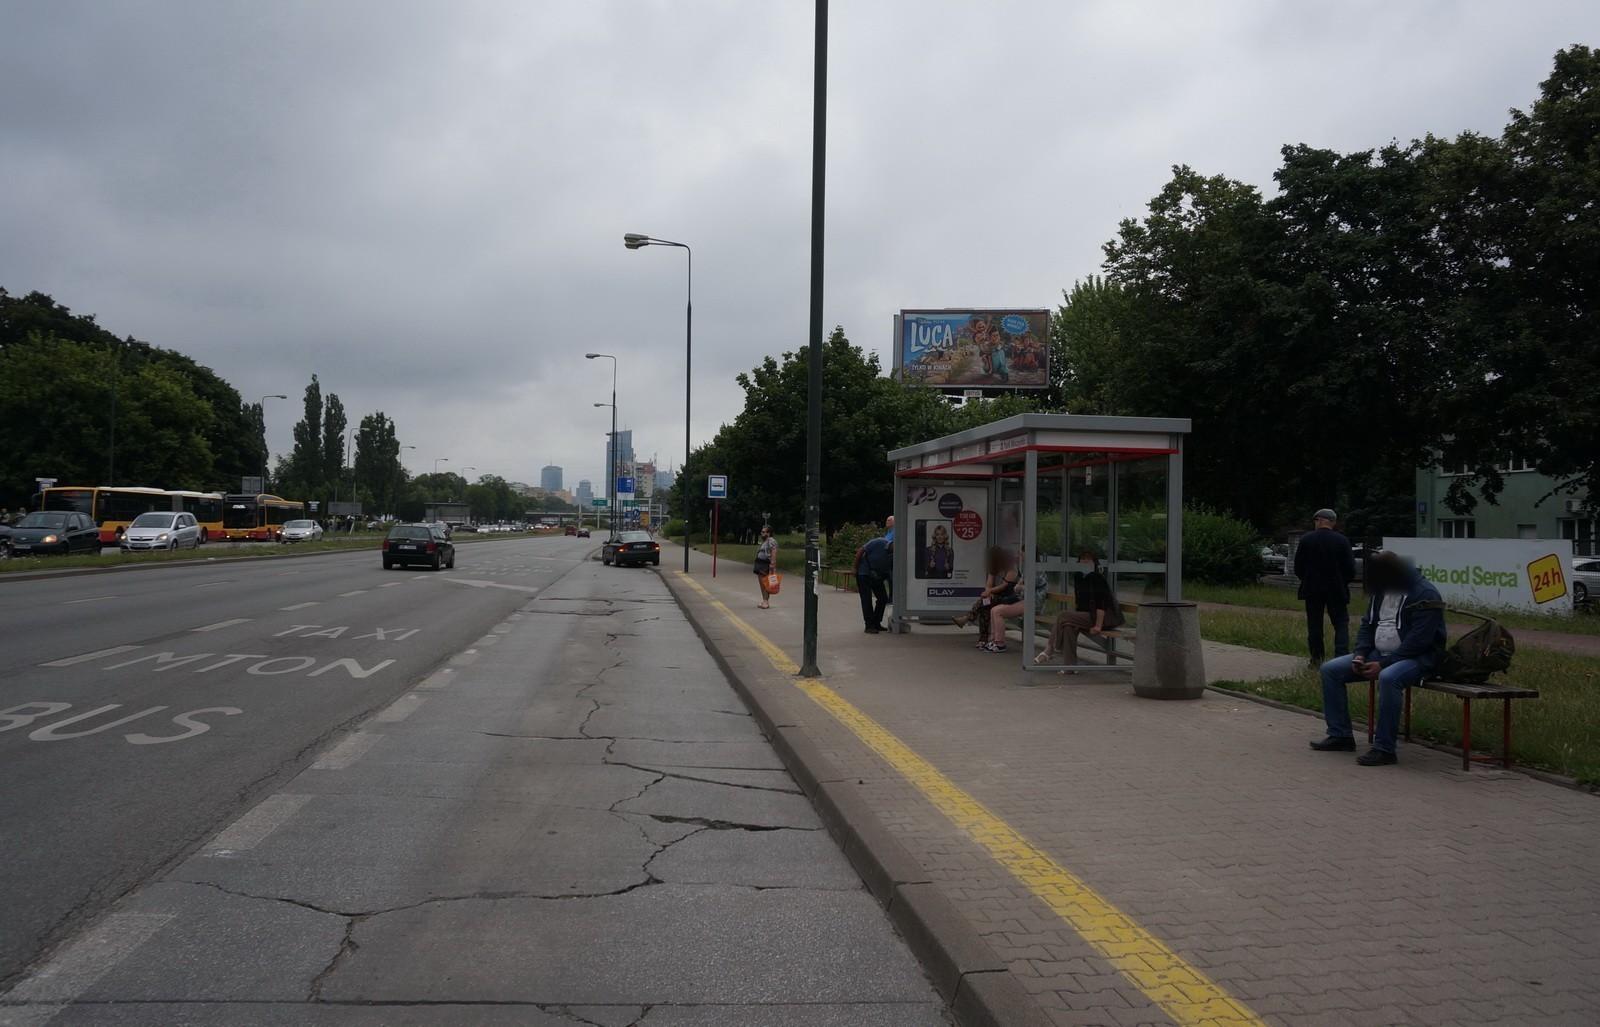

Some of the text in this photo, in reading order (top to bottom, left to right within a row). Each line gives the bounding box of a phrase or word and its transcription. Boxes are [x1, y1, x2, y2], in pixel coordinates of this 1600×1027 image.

[911, 322, 953, 352] LUCA
[962, 527, 974, 538] 25
[1451, 565, 1470, 585] od
[1472, 566, 1518, 588] Serca
[272, 625, 421, 641] TAXI
[103, 652, 396, 678] MTON
[0, 702, 243, 745] BUS
